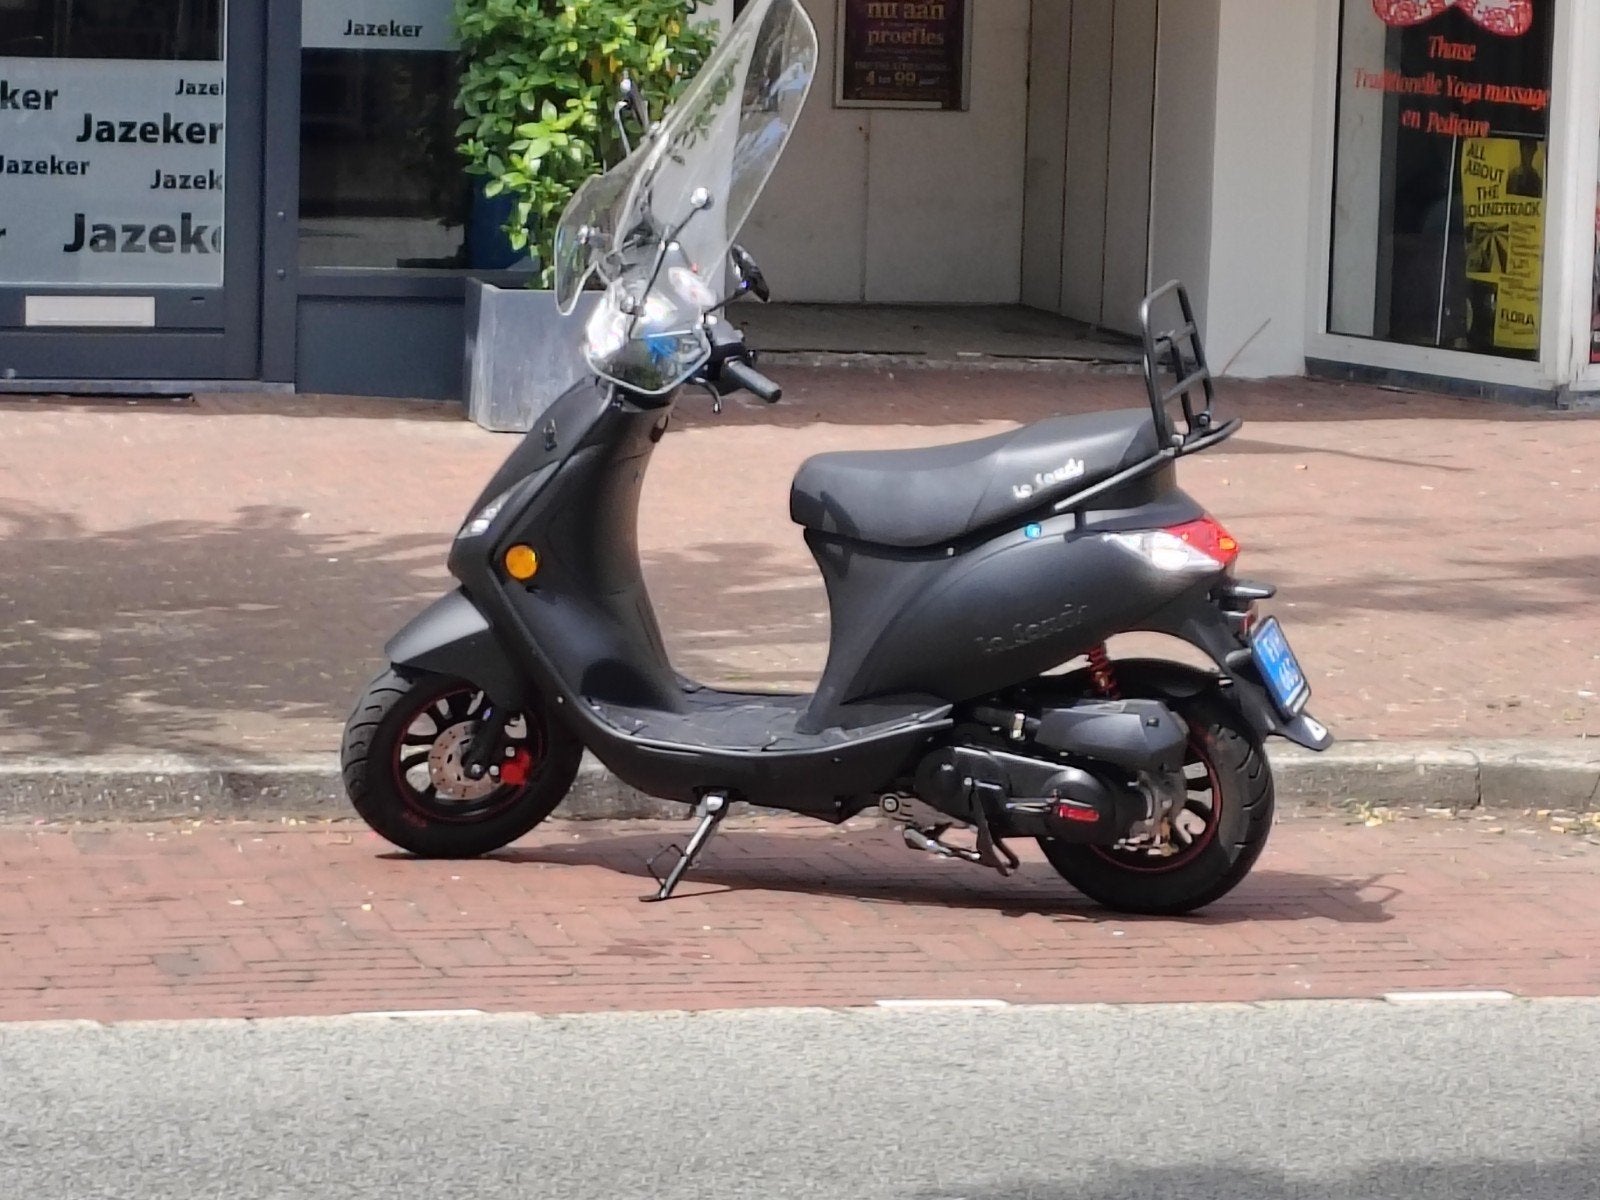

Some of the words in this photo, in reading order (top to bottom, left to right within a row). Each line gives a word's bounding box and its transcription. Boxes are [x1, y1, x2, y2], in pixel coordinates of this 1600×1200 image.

[343, 19, 424, 37] Jazeker
[76, 113, 223, 144] Jazeker
[1466, 143, 1487, 161] ALL
[0, 155, 90, 175] Jazeker
[1464, 160, 1506, 184] ABOUT
[1477, 185, 1500, 202] THE
